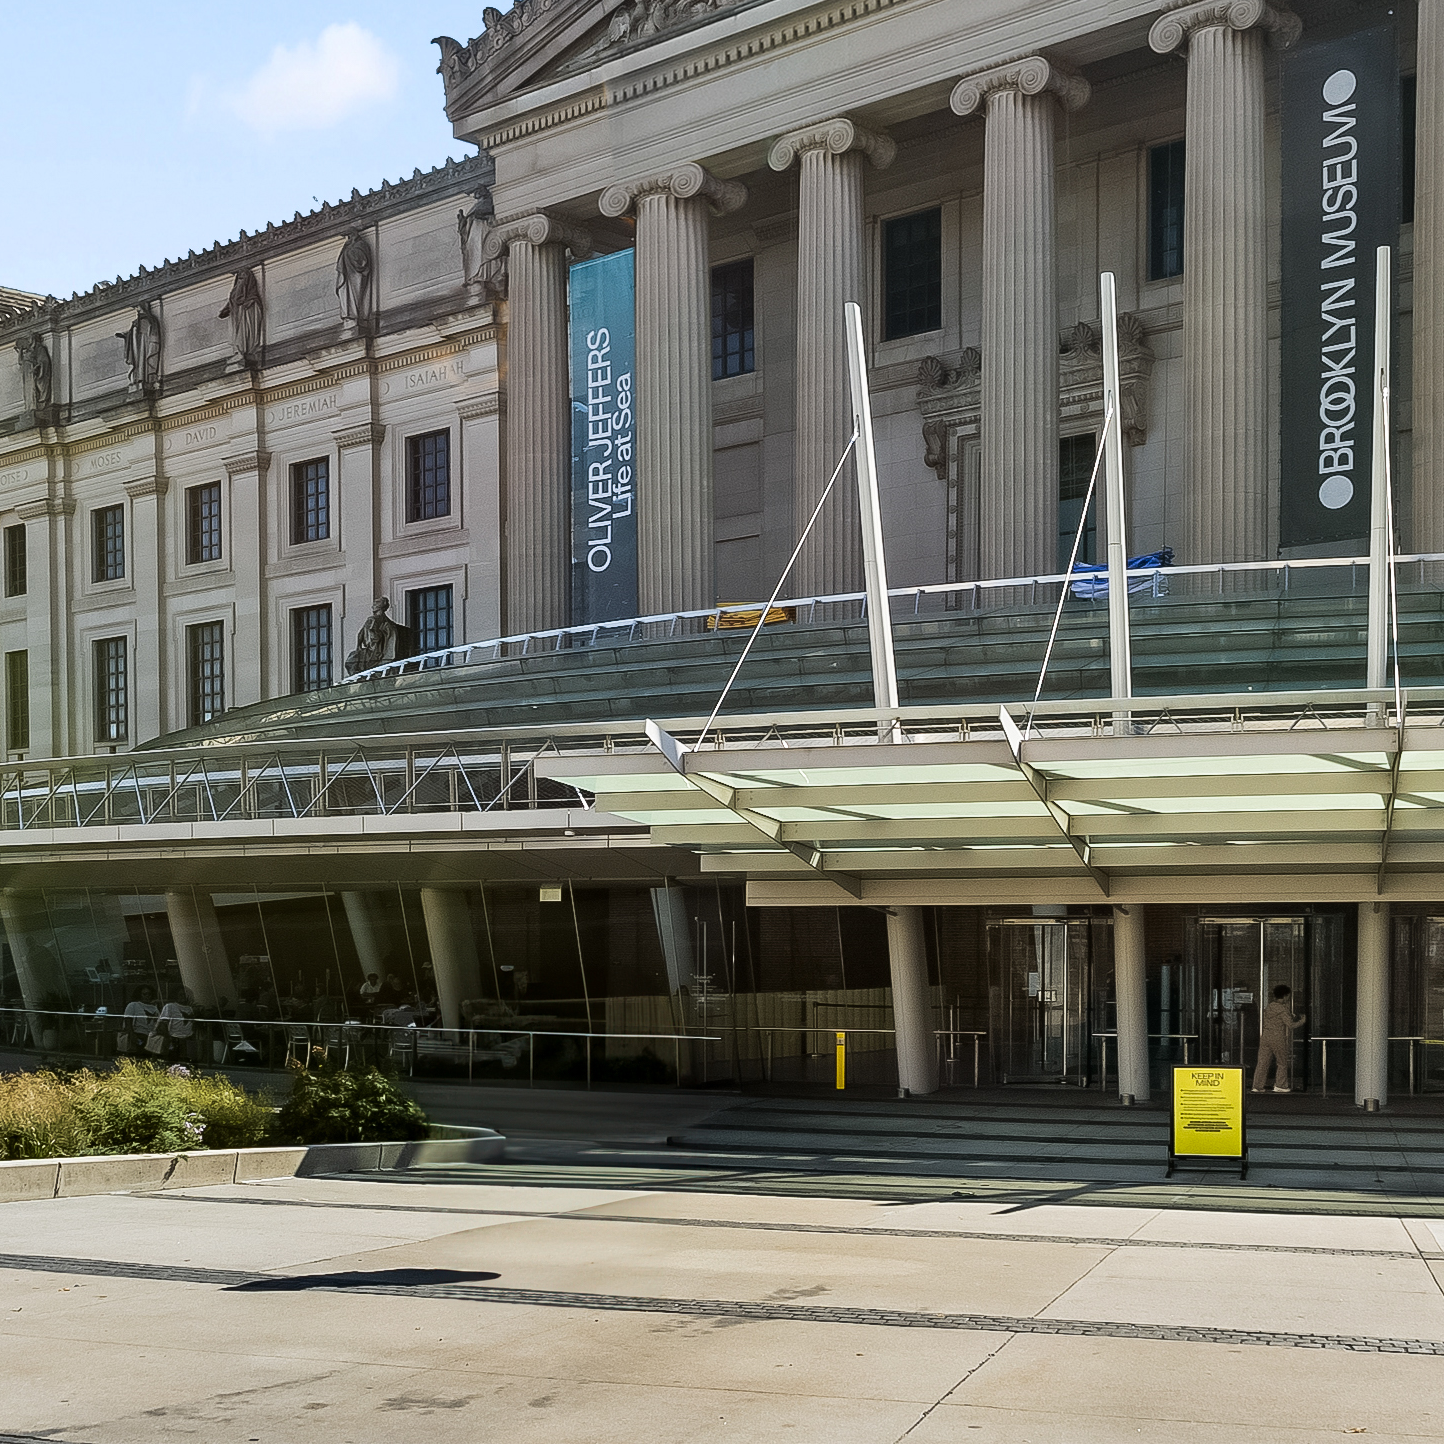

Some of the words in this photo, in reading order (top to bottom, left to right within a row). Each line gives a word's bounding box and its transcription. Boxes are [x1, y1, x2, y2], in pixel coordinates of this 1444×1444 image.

[1321, 103, 1358, 269] MUSEUM
[586, 327, 613, 457] JEFFERS
[612, 372, 632, 429] Sea
[1319, 278, 1356, 474] BROOKLYN
[279, 395, 337, 421] JEREMIAH
[89, 451, 122, 471] MOSES
[185, 426, 217, 446] DAVID
[614, 431, 632, 464] at
[587, 458, 613, 573] OLIVER
[612, 465, 632, 519] Life
